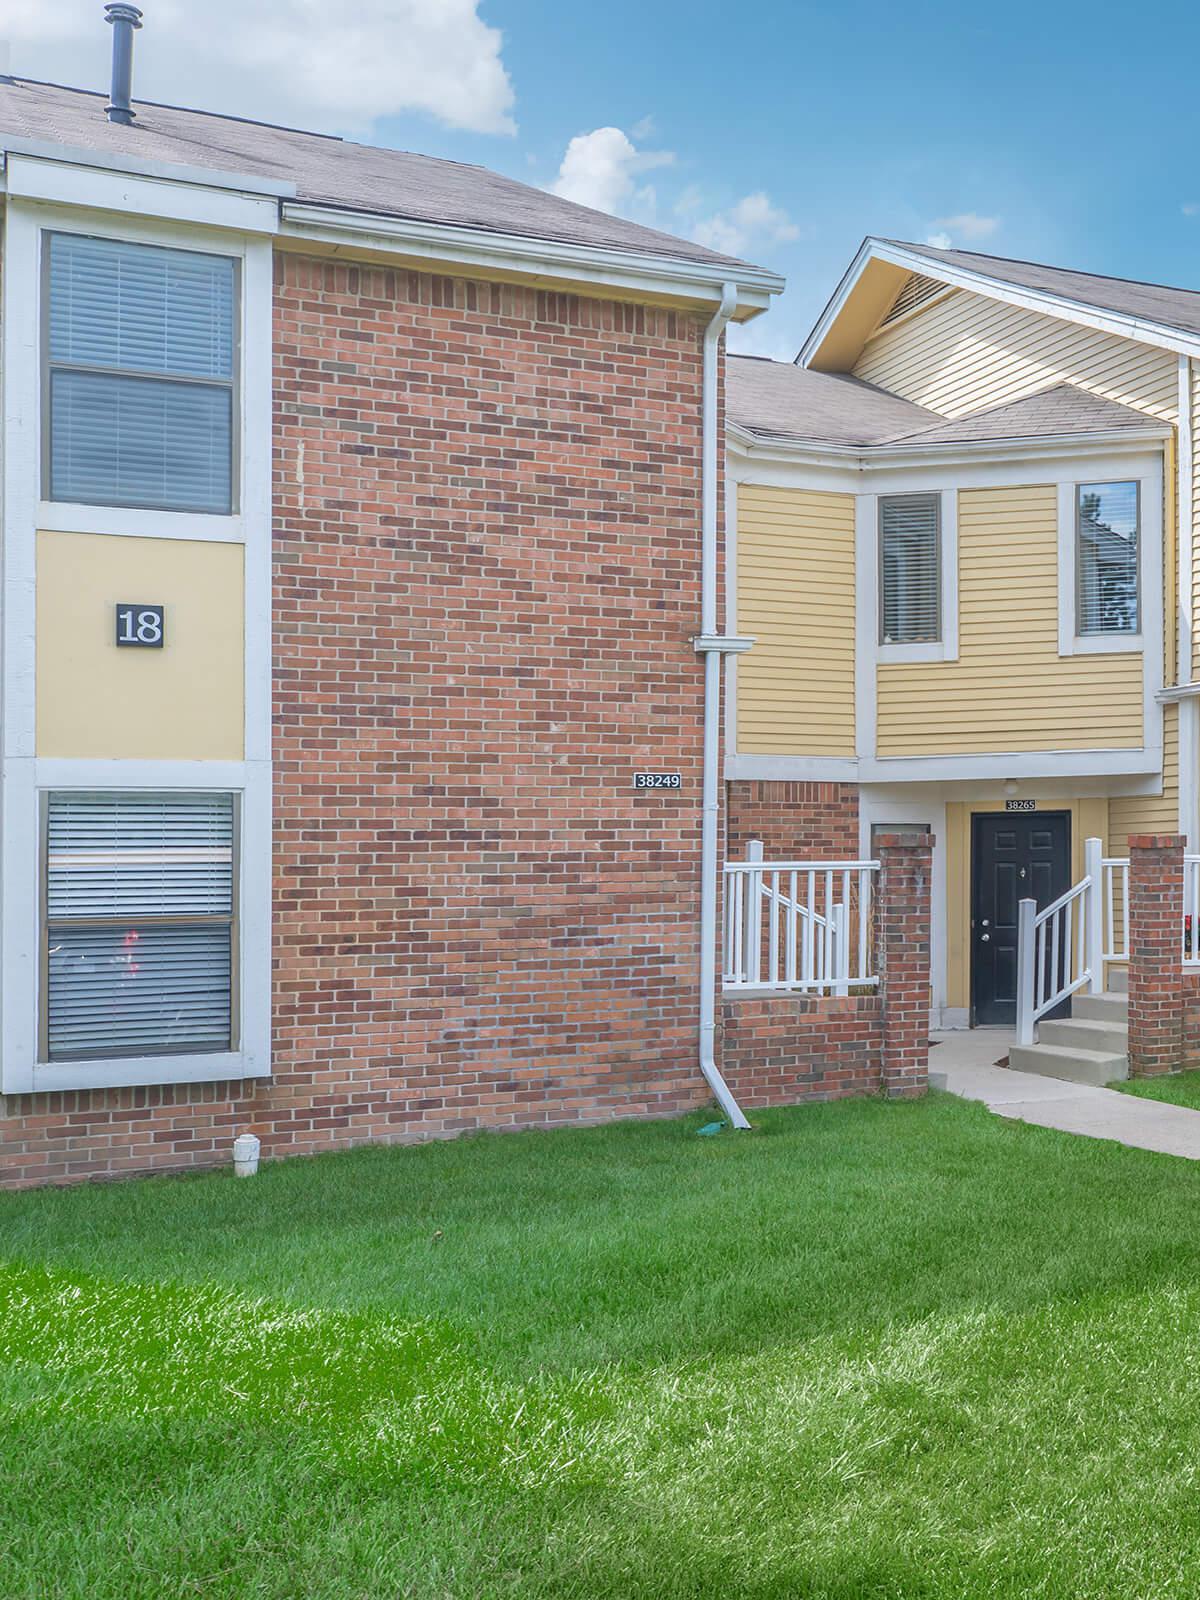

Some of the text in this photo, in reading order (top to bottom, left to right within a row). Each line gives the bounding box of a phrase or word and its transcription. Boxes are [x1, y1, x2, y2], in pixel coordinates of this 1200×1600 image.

[119, 610, 162, 643] 18
[637, 775, 680, 787] 38249
[1007, 800, 1035, 810] 38265
